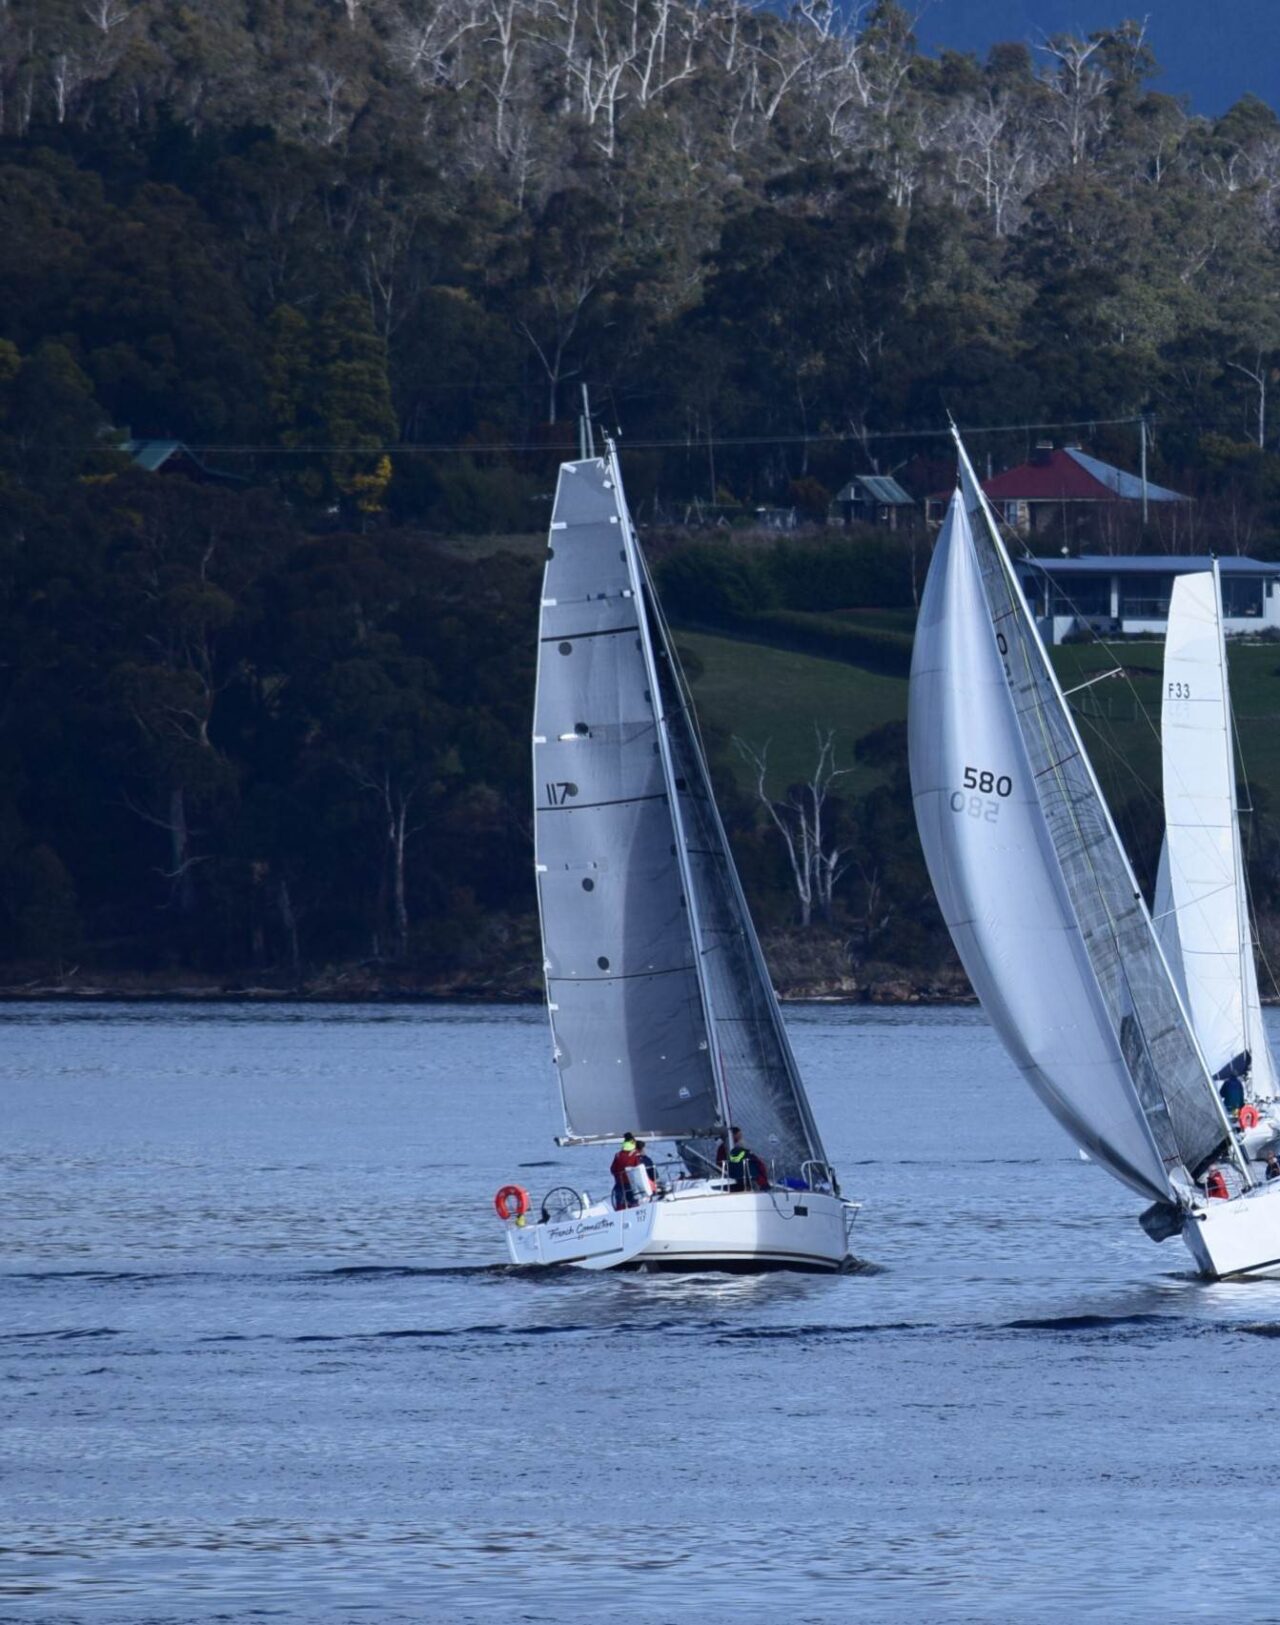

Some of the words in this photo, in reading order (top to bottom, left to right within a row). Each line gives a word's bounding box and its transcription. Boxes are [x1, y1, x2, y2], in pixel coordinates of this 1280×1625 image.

[1168, 682, 1190, 699] F33
[963, 766, 1012, 797] 580
[546, 782, 569, 805] 117
